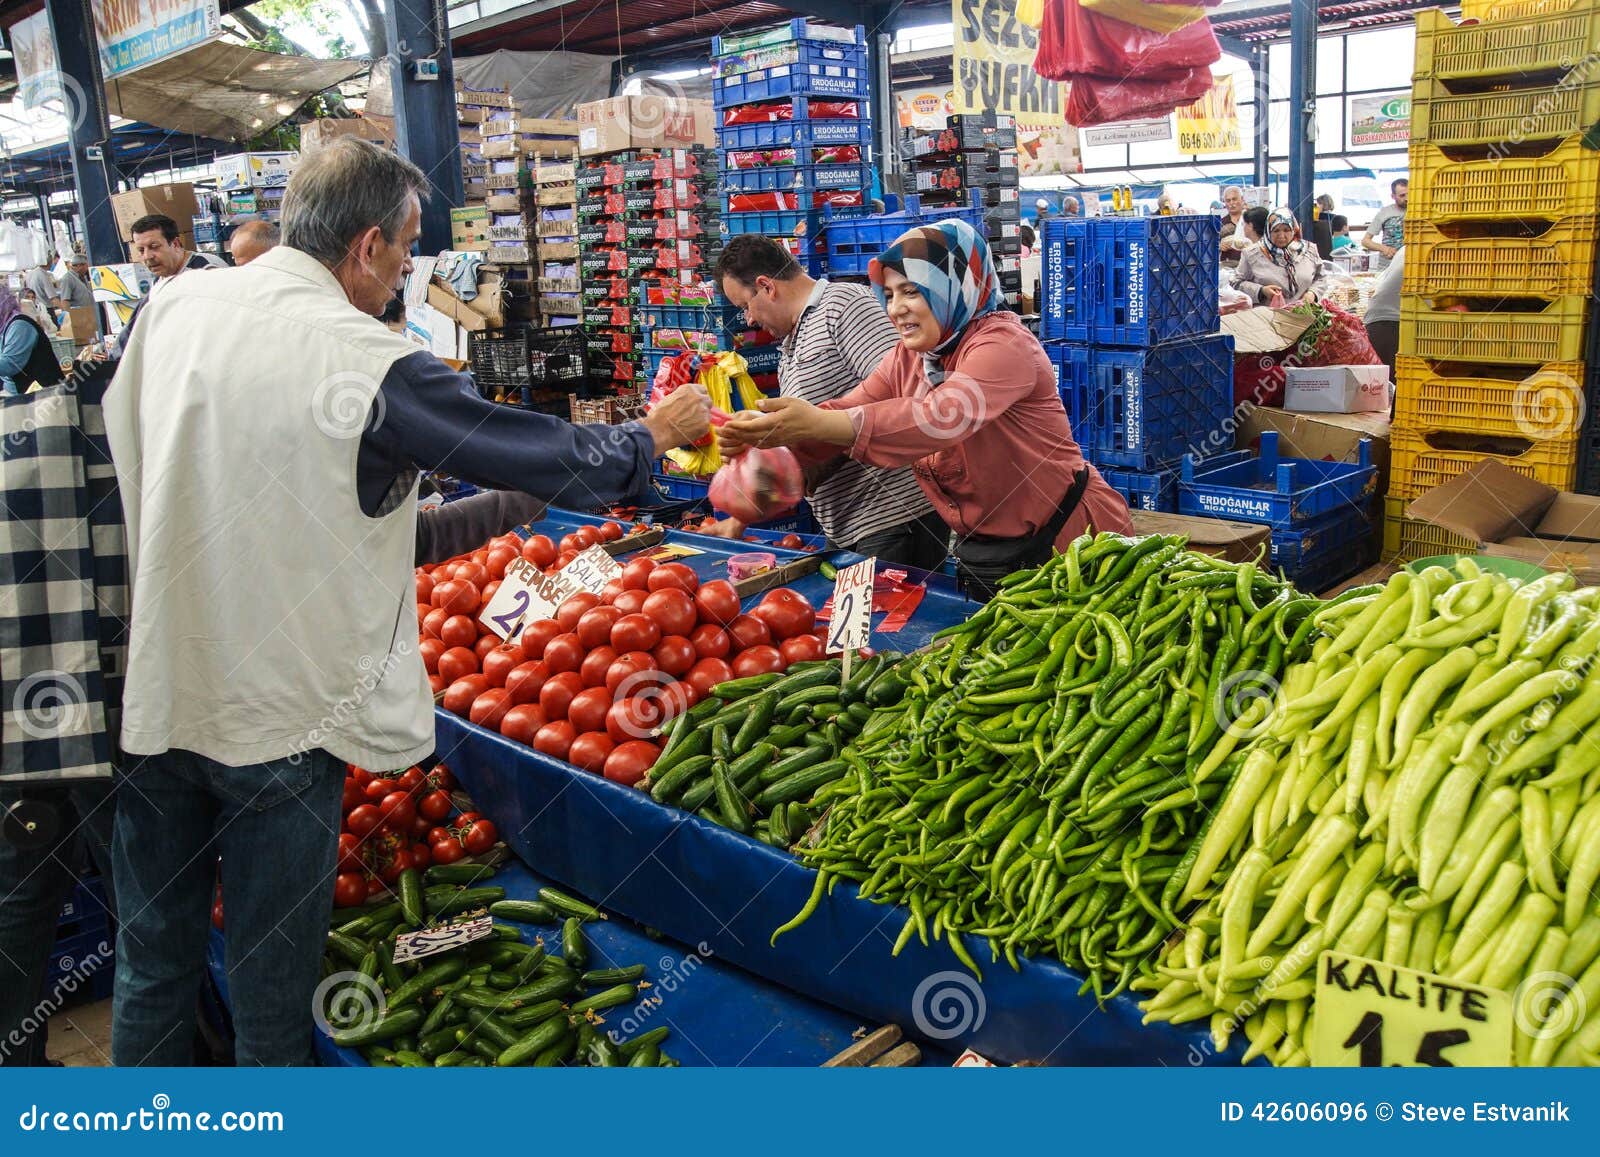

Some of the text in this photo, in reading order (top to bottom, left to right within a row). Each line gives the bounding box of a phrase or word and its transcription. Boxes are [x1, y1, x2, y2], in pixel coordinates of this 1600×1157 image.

[811, 78, 856, 89] ERDOĞANLAR
[813, 125, 858, 135] ERDOĞANLAR
[1180, 132, 1201, 149] 0546
[626, 168, 649, 178] aerogen
[579, 203, 602, 213] aerogen
[627, 198, 651, 208] aerogen
[579, 232, 603, 241] aerogen
[628, 226, 652, 236] aerogen
[629, 256, 653, 265] aerogen
[1053, 242, 1063, 318] ERDOĞANLAR
[1128, 242, 1138, 324] ERDOĞANLAR
[1126, 371, 1135, 449] ERDOĞANLAR
[1199, 495, 1270, 511] ERDOĞANLAR
[509, 557, 565, 606] PEMBE
[491, 590, 530, 637] 2
[1325, 956, 1489, 1022] KALİTE
